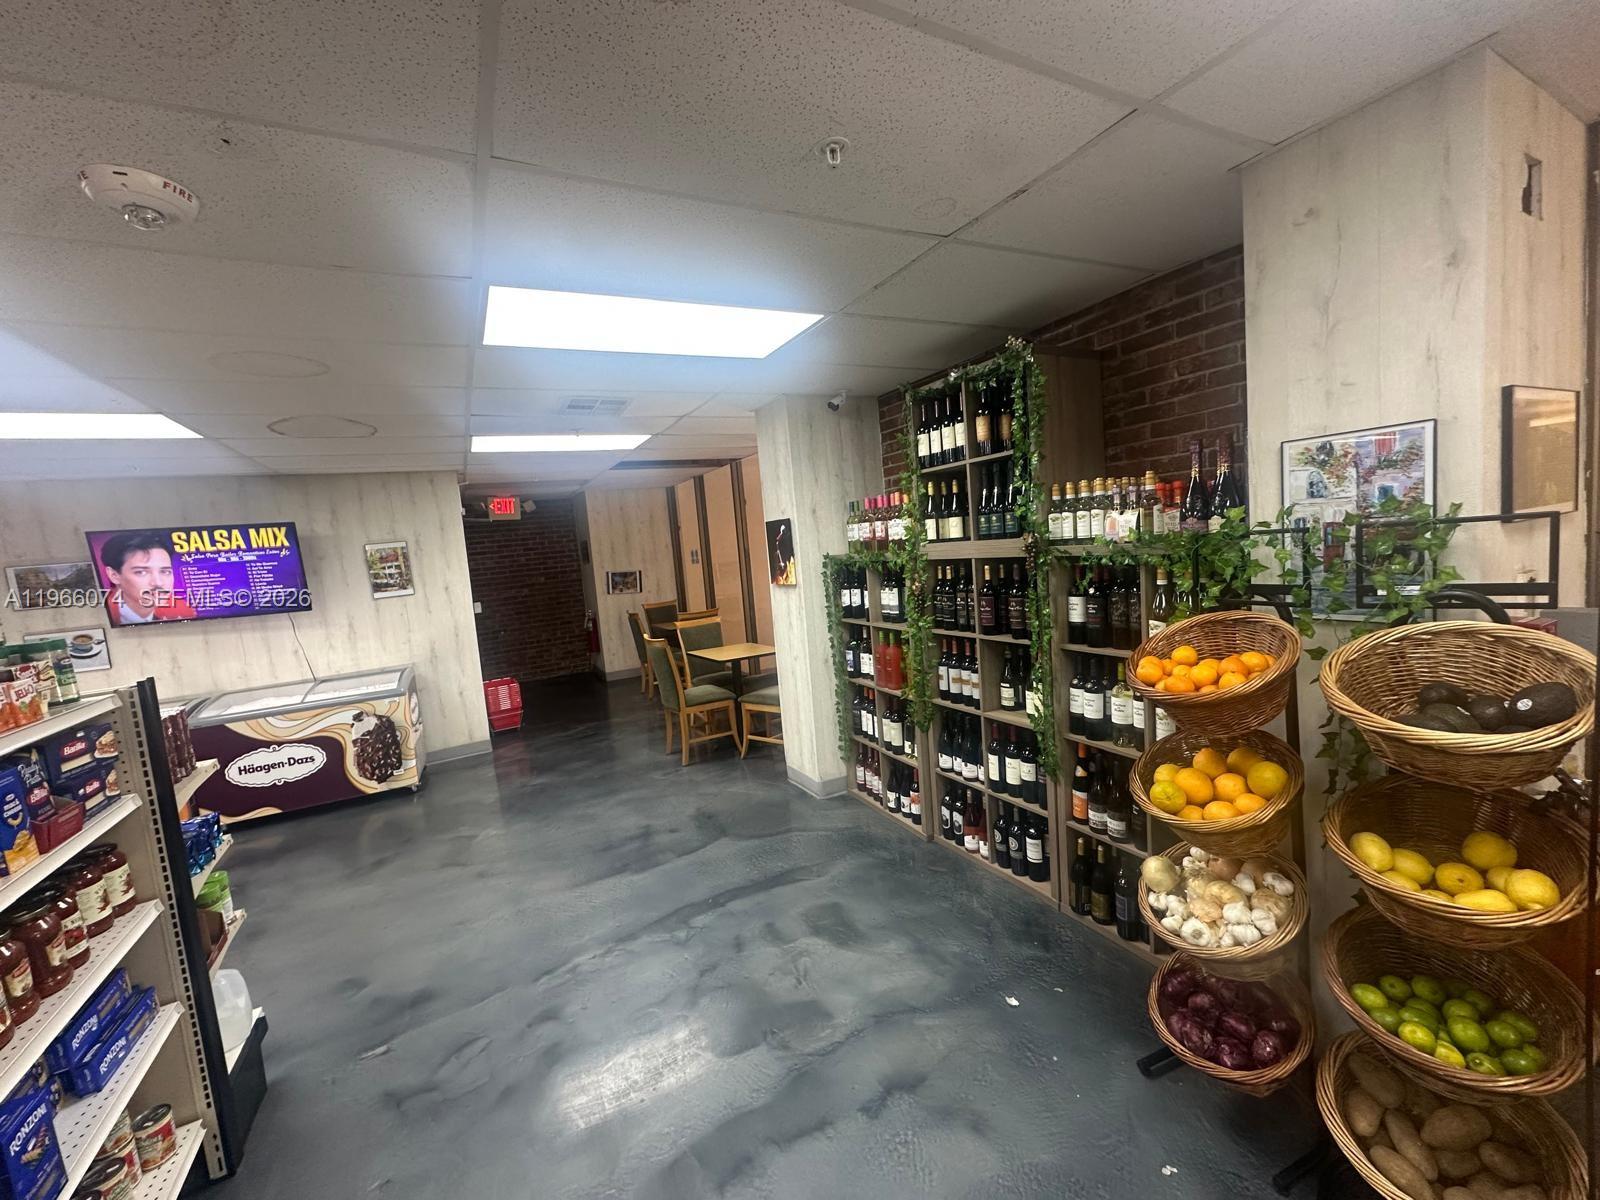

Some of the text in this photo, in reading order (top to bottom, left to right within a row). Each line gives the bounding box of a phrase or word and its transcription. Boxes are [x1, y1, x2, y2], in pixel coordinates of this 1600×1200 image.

[162, 181, 193, 203] FIRE
[494, 498, 515, 514] EXIT
[171, 526, 290, 553] SALSA MIX
[64, 741, 87, 756] Barilla
[237, 755, 316, 776] Häagen-Dazs
[71, 1014, 99, 1050] RONZONI
[100, 1036, 127, 1075] RONZONI
[9, 1103, 48, 1156] RONZONI
